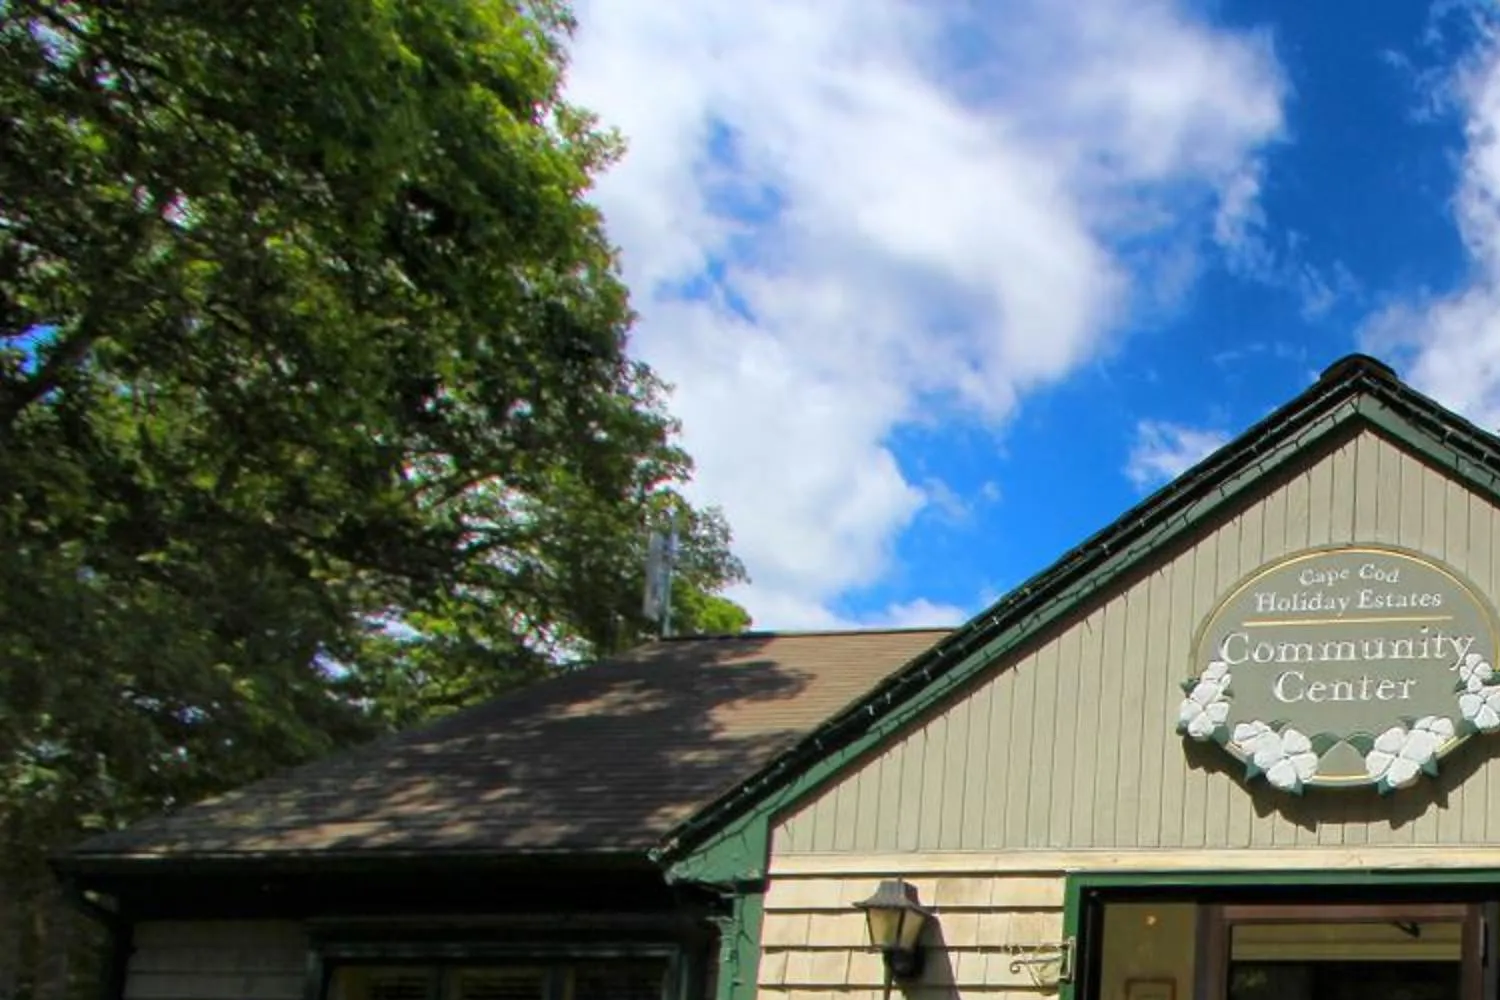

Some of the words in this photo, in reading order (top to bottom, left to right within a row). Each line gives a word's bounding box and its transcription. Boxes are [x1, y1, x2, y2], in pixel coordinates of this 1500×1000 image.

[1299, 568, 1350, 587] Cape
[1358, 563, 1400, 583] Cod
[1253, 591, 1350, 617] Holiday
[1356, 589, 1442, 609] Estates
[1219, 626, 1475, 671] Community
[1273, 670, 1417, 703] Center
